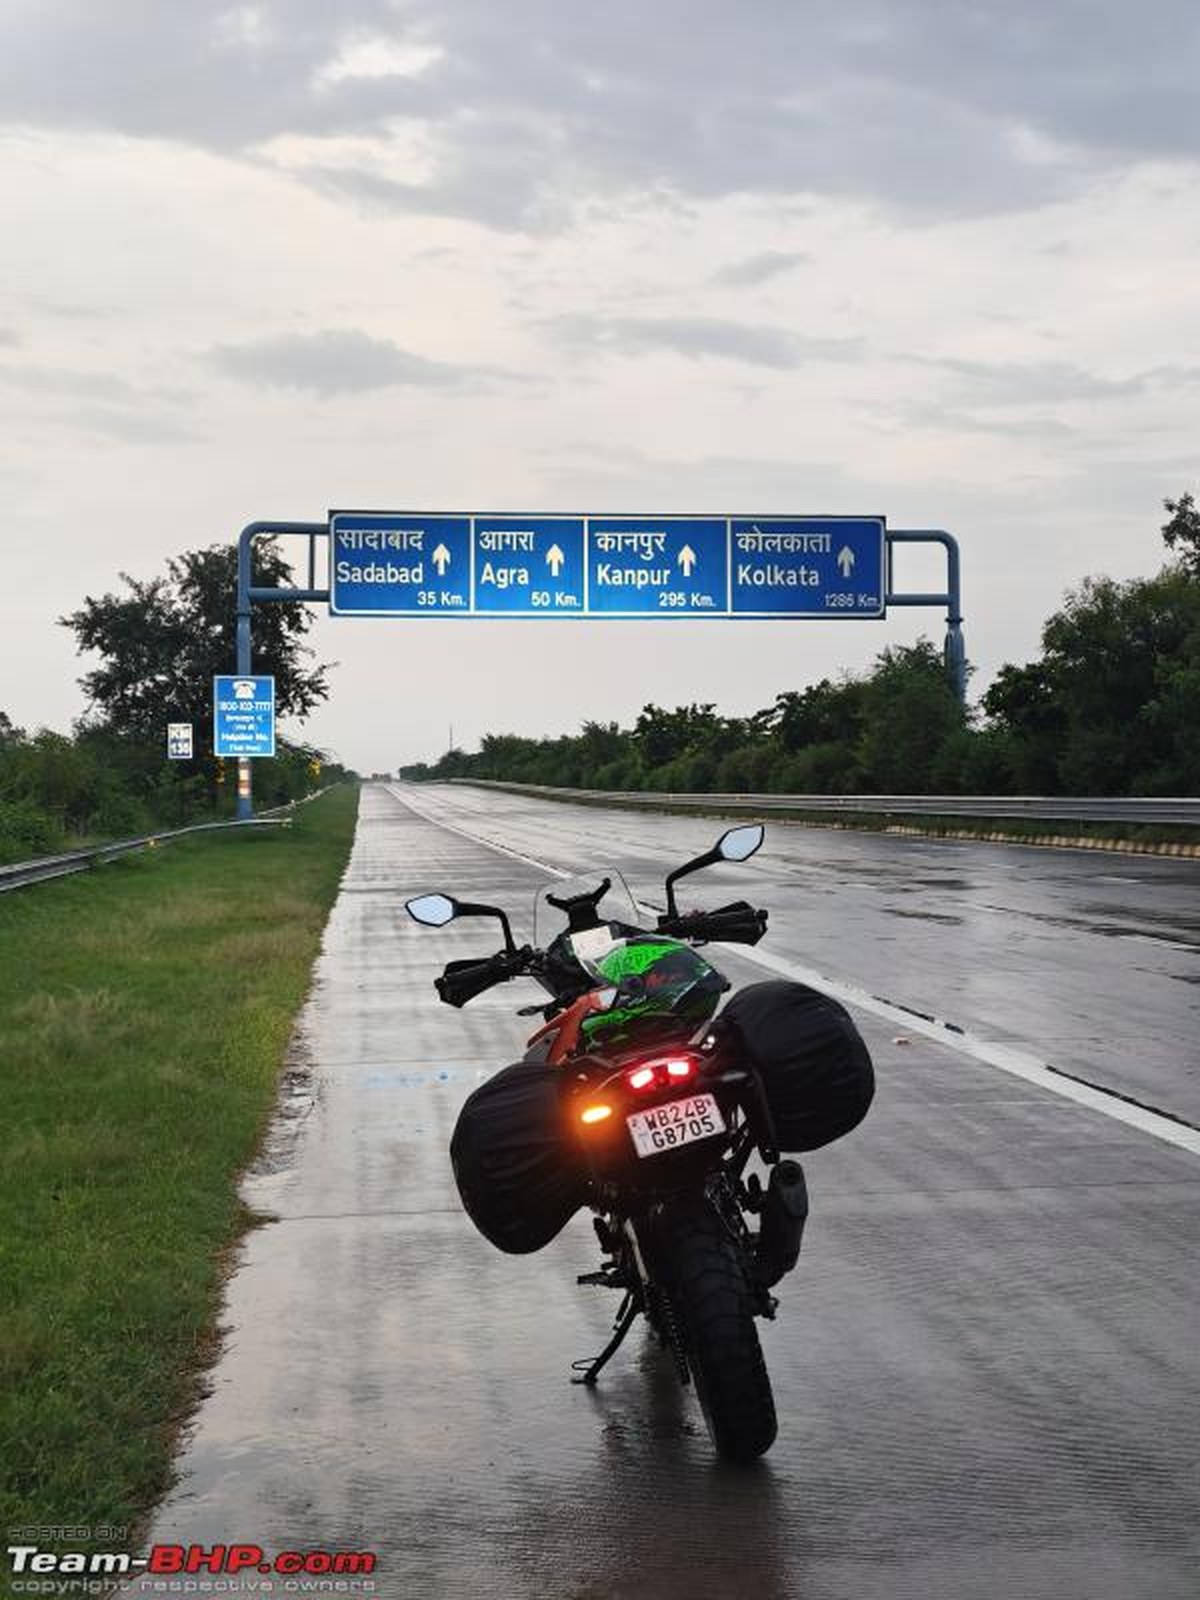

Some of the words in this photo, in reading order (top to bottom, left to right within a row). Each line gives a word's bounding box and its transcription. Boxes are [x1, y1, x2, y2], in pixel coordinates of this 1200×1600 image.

[337, 529, 424, 550] सादाबाद
[479, 530, 534, 551] आगरा
[595, 532, 667, 559] कानपुर
[735, 525, 831, 554] कोलकाता
[337, 561, 424, 584] Sadabad
[480, 563, 529, 588] Agra
[596, 564, 671, 589] Kanpur
[737, 564, 820, 587] Kolkata
[417, 591, 435, 605] 35
[531, 592, 549, 606] 50
[658, 592, 685, 607] 295
[644, 1098, 707, 1131] WB24B
[651, 1115, 715, 1148] G8705
